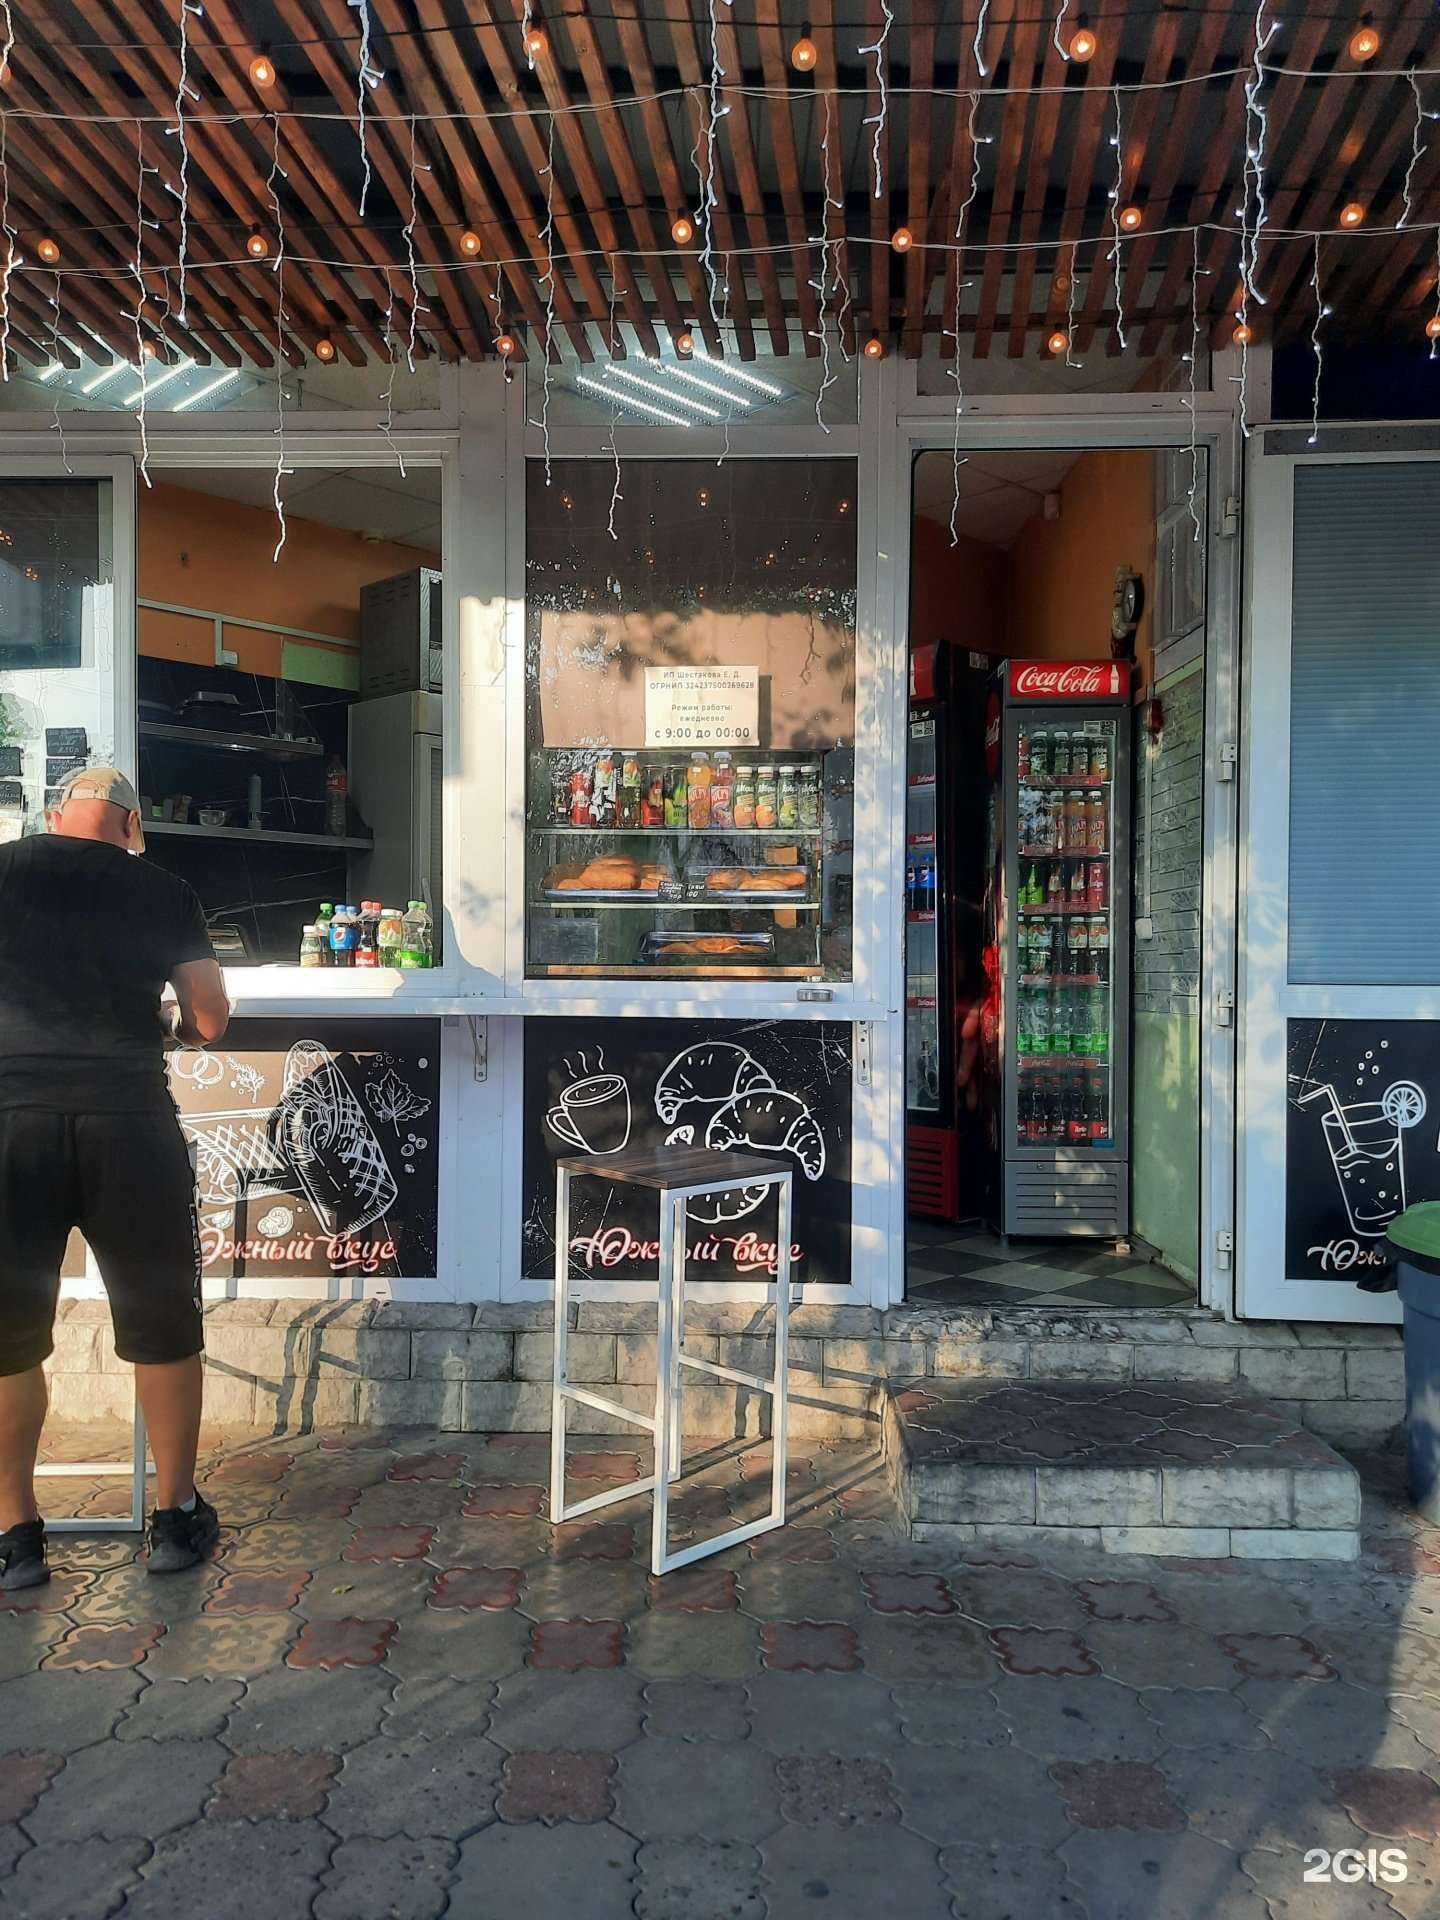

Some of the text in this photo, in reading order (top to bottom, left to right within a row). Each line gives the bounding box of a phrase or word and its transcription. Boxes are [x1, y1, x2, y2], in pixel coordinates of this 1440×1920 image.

[663, 671, 675, 679] ИП
[1016, 665, 1105, 693] Coca-Cola
[649, 682, 683, 690] ОГРНИП
[655, 727, 750, 739] с 9:00 до 00:00
